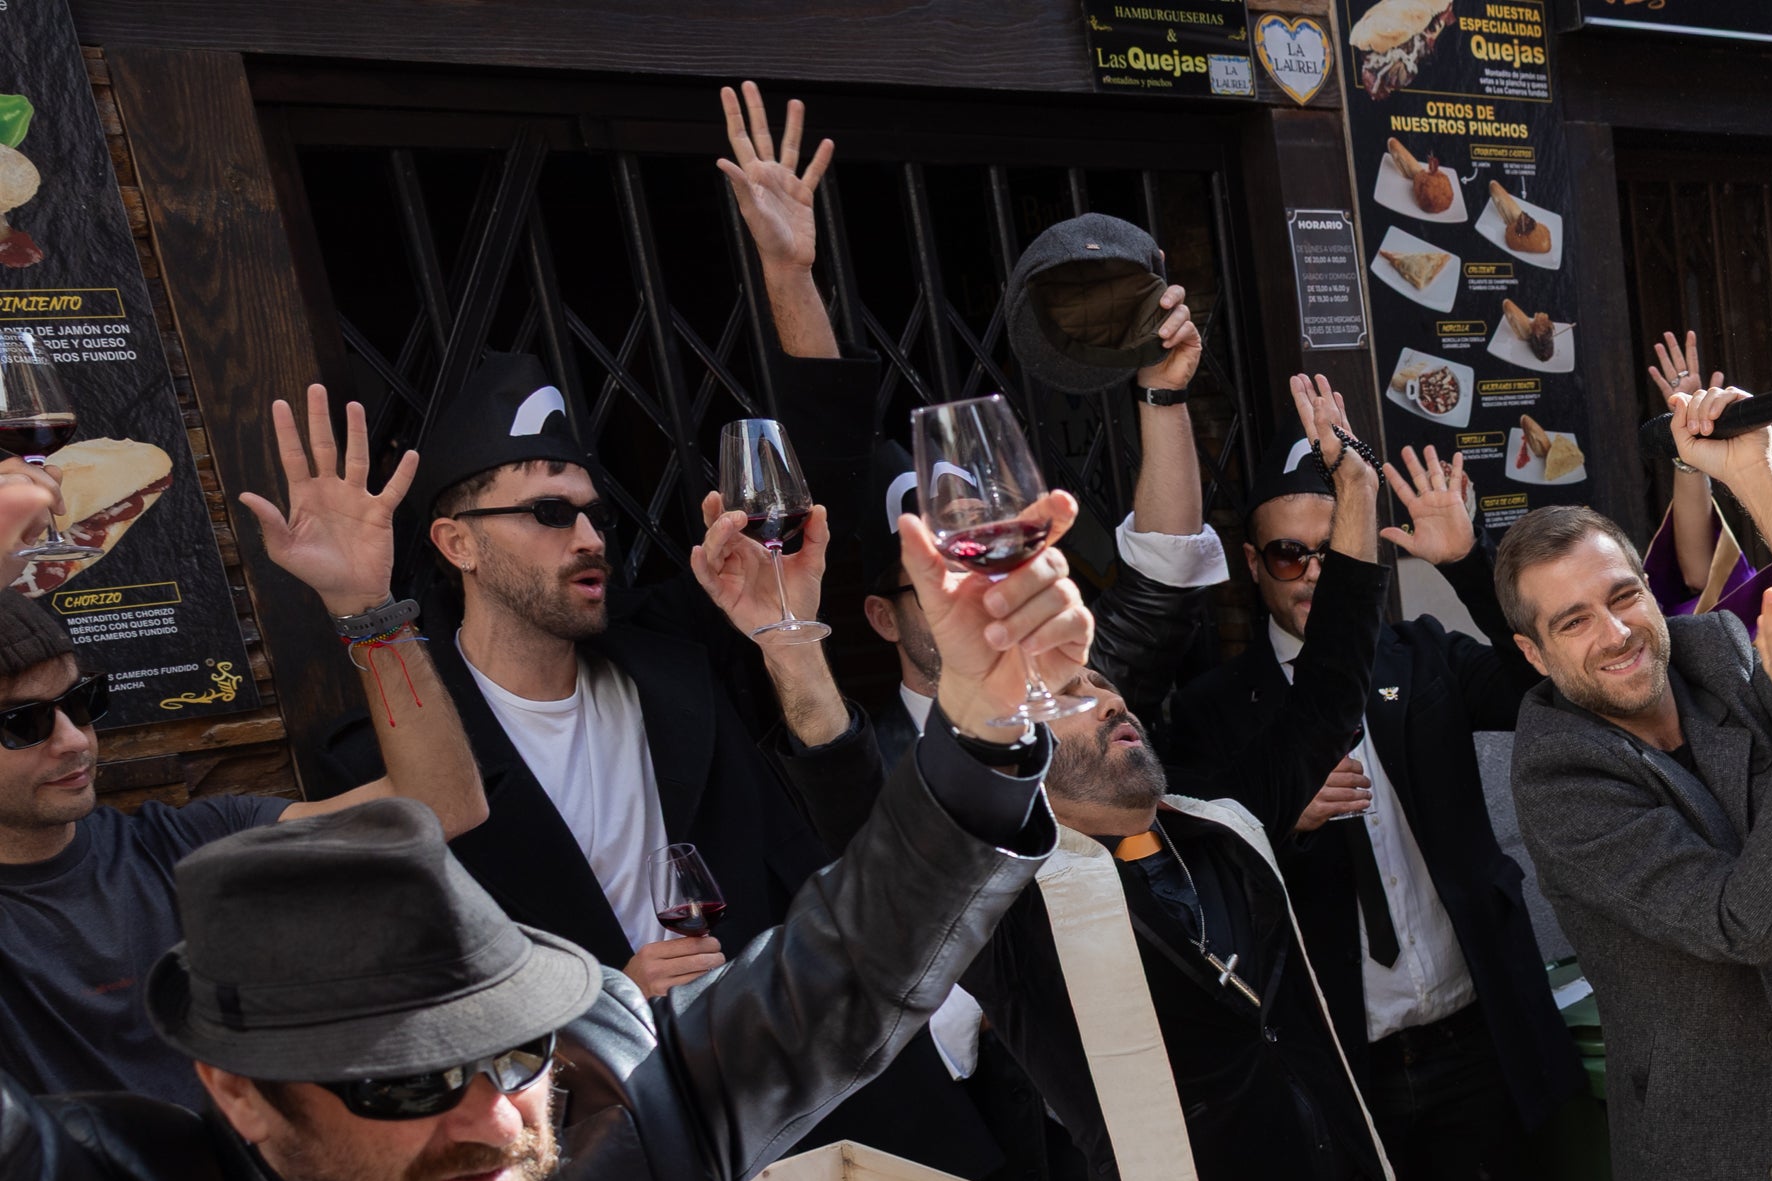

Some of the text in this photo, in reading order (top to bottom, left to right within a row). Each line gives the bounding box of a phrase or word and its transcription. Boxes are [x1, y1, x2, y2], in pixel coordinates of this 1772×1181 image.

[1114, 6, 1224, 25] HAMBURGUESERIAS
[1486, 4, 1541, 22] NUESTRA
[1167, 28, 1178, 43] &
[1459, 17, 1542, 38] ESPECIALIDAD
[1288, 43, 1306, 58] LA
[1471, 34, 1545, 68] Quejas
[1096, 46, 1207, 77] Las Quejas
[1274, 58, 1321, 75] LAUREL
[1225, 66, 1238, 76] LA
[1216, 78, 1249, 89] LAUREL
[1426, 101, 1495, 121] OTROS DE
[1390, 115, 1529, 139] NUESTROS PINCHOS
[1298, 220, 1343, 230] HORARIO
[0, 296, 82, 313] IMIENTO
[37, 327, 55, 336] DE
[57, 323, 101, 336] JAMÓN
[103, 324, 131, 335] CON
[43, 339, 70, 350] RDE
[70, 340, 79, 349] Y
[83, 338, 126, 350] QUESO
[82, 351, 137, 362] FUNDIDO
[64, 592, 122, 608] CHORIZO
[67, 607, 175, 626] MONTADITO DE CHORIZO
[108, 622, 129, 631] CON
[129, 619, 161, 629] QUESO
[162, 617, 175, 625] DE
[72, 626, 178, 644] LOS CAMEROS FUNDIDO
[116, 667, 159, 680] CAMEROS
[160, 663, 199, 675] FUNDIDO
[108, 681, 146, 692] LANCHA
